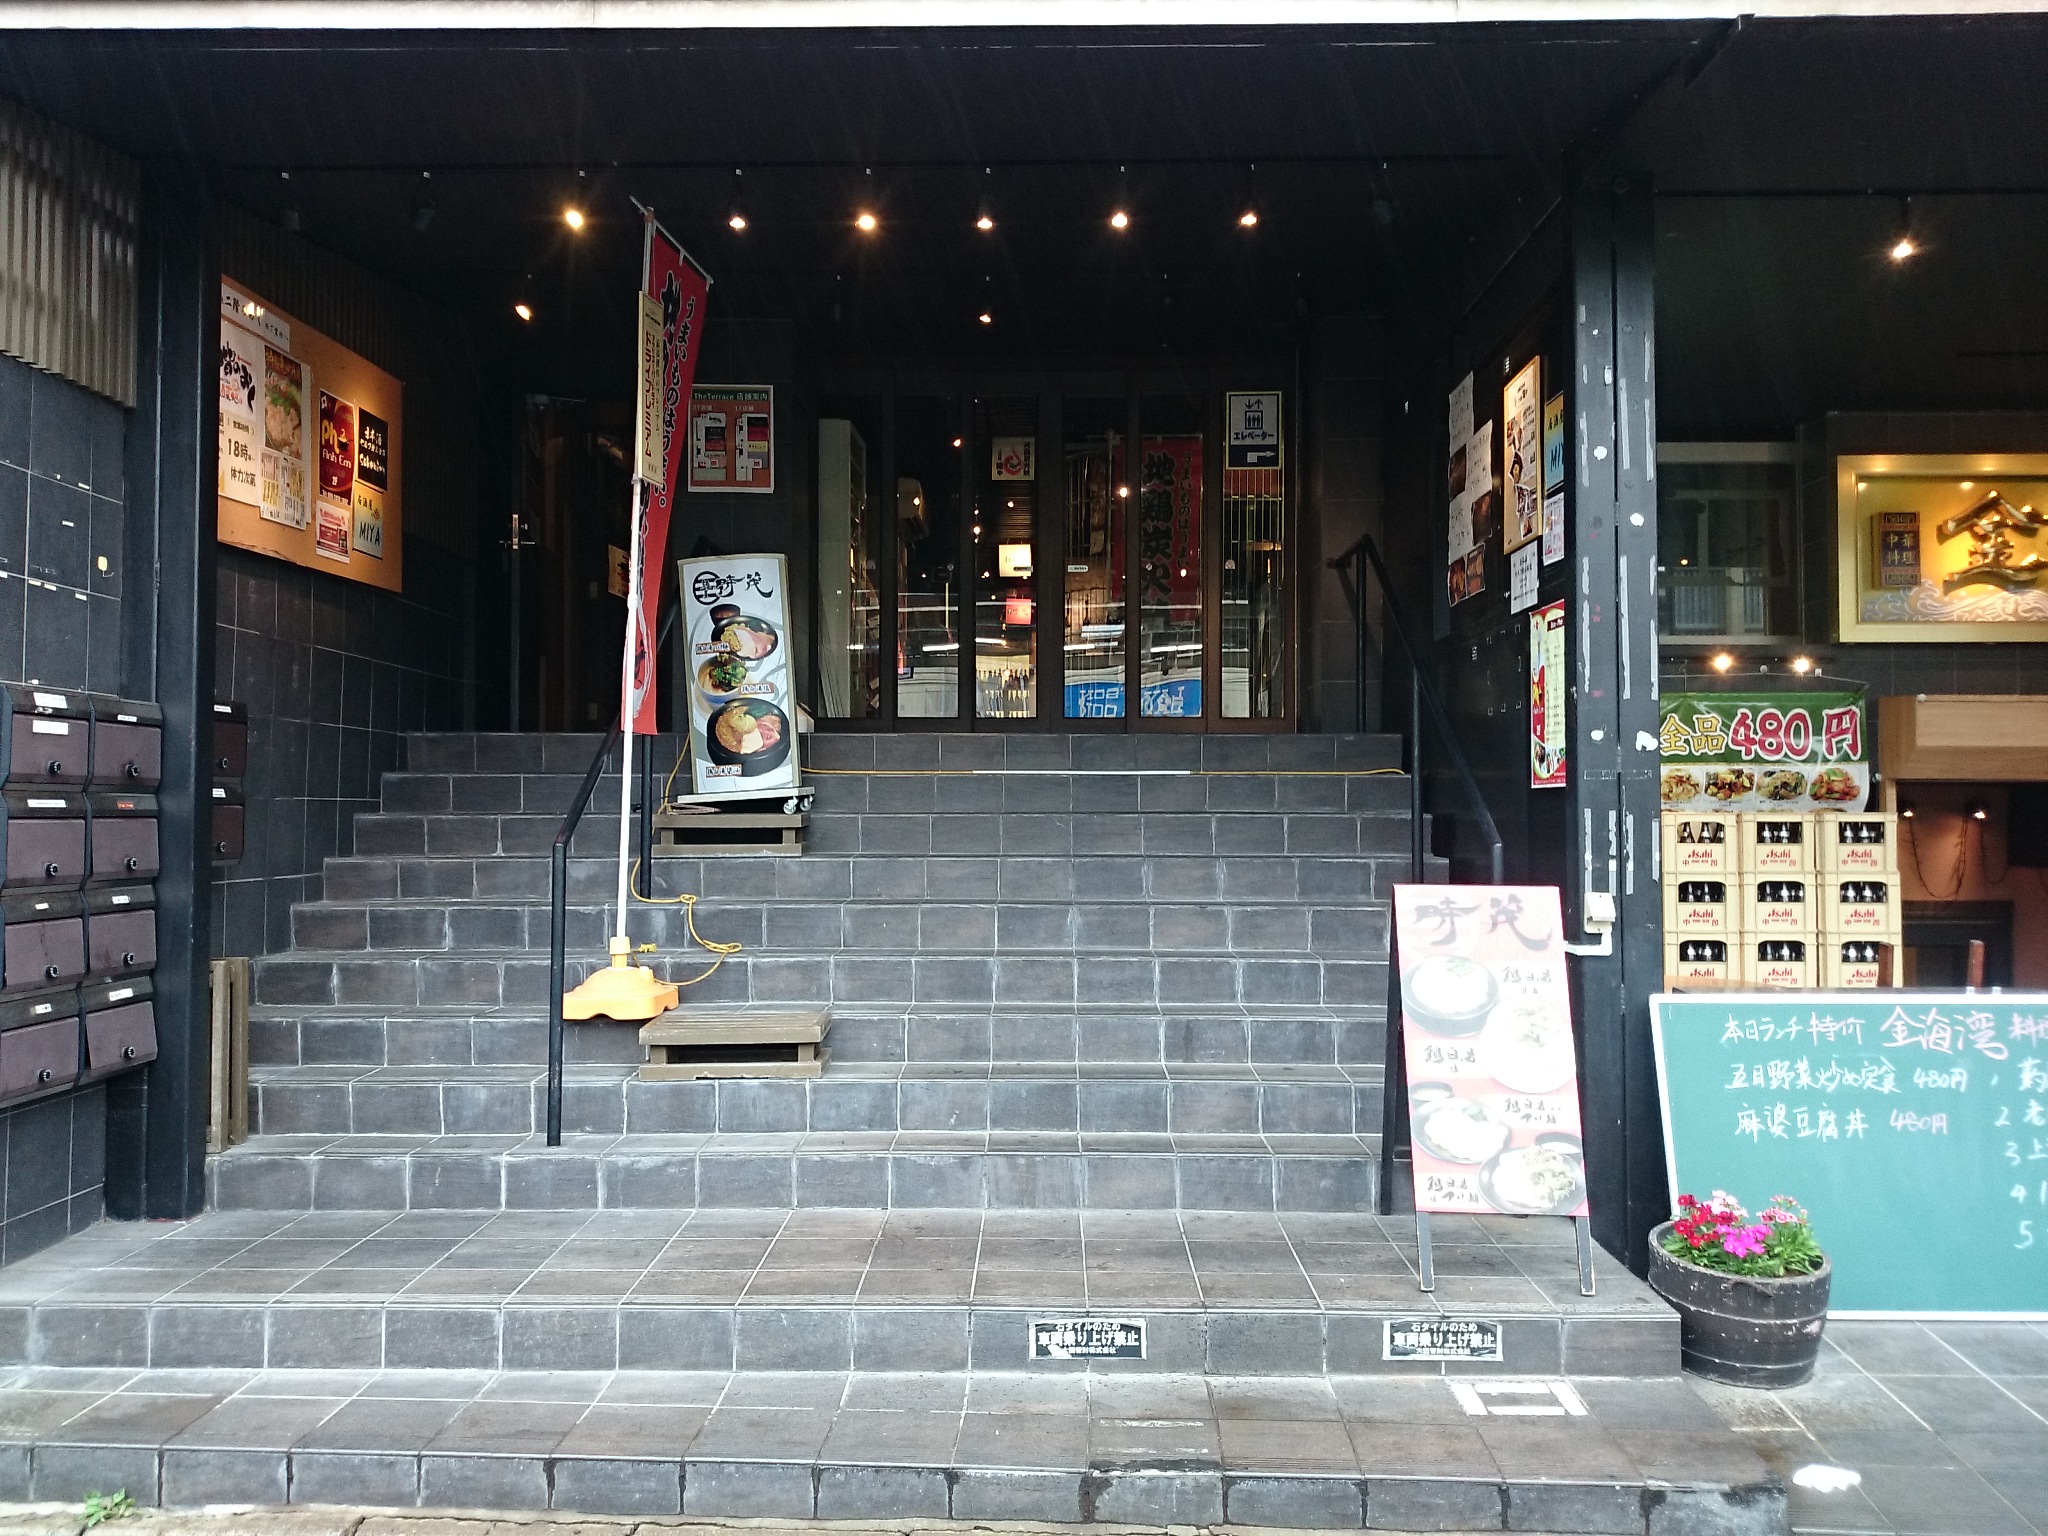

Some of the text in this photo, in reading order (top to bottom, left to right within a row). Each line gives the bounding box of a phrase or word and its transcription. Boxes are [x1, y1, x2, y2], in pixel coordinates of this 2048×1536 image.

[1233, 431, 1274, 440] エレベーター
[338, 454, 351, 468] Em
[231, 466, 256, 487] 体力次第
[359, 521, 380, 546] MIYA
[1688, 849, 1713, 858] Asahi
[1766, 849, 1791, 858] Asahi
[1847, 849, 1872, 858] Asahi
[1689, 909, 1714, 918] Asahi
[1768, 908, 1793, 917] Asahi
[1850, 909, 1875, 918] Asahi
[1690, 967, 1715, 977] Asahi
[1768, 967, 1792, 977] Asahi
[1852, 969, 1877, 978] Asahi
[1913, 1067, 1967, 1093] 480円
[1890, 1108, 1948, 1135] 480円
[2014, 1220, 2033, 1249] 5
[1055, 1322, 1121, 1332] 石タイルのため
[1411, 1322, 1478, 1332] 石タイルのため
[1037, 1331, 1140, 1347] 車両乗り上げ禁止
[1392, 1332, 1496, 1348] 車両乗り上げ禁止
